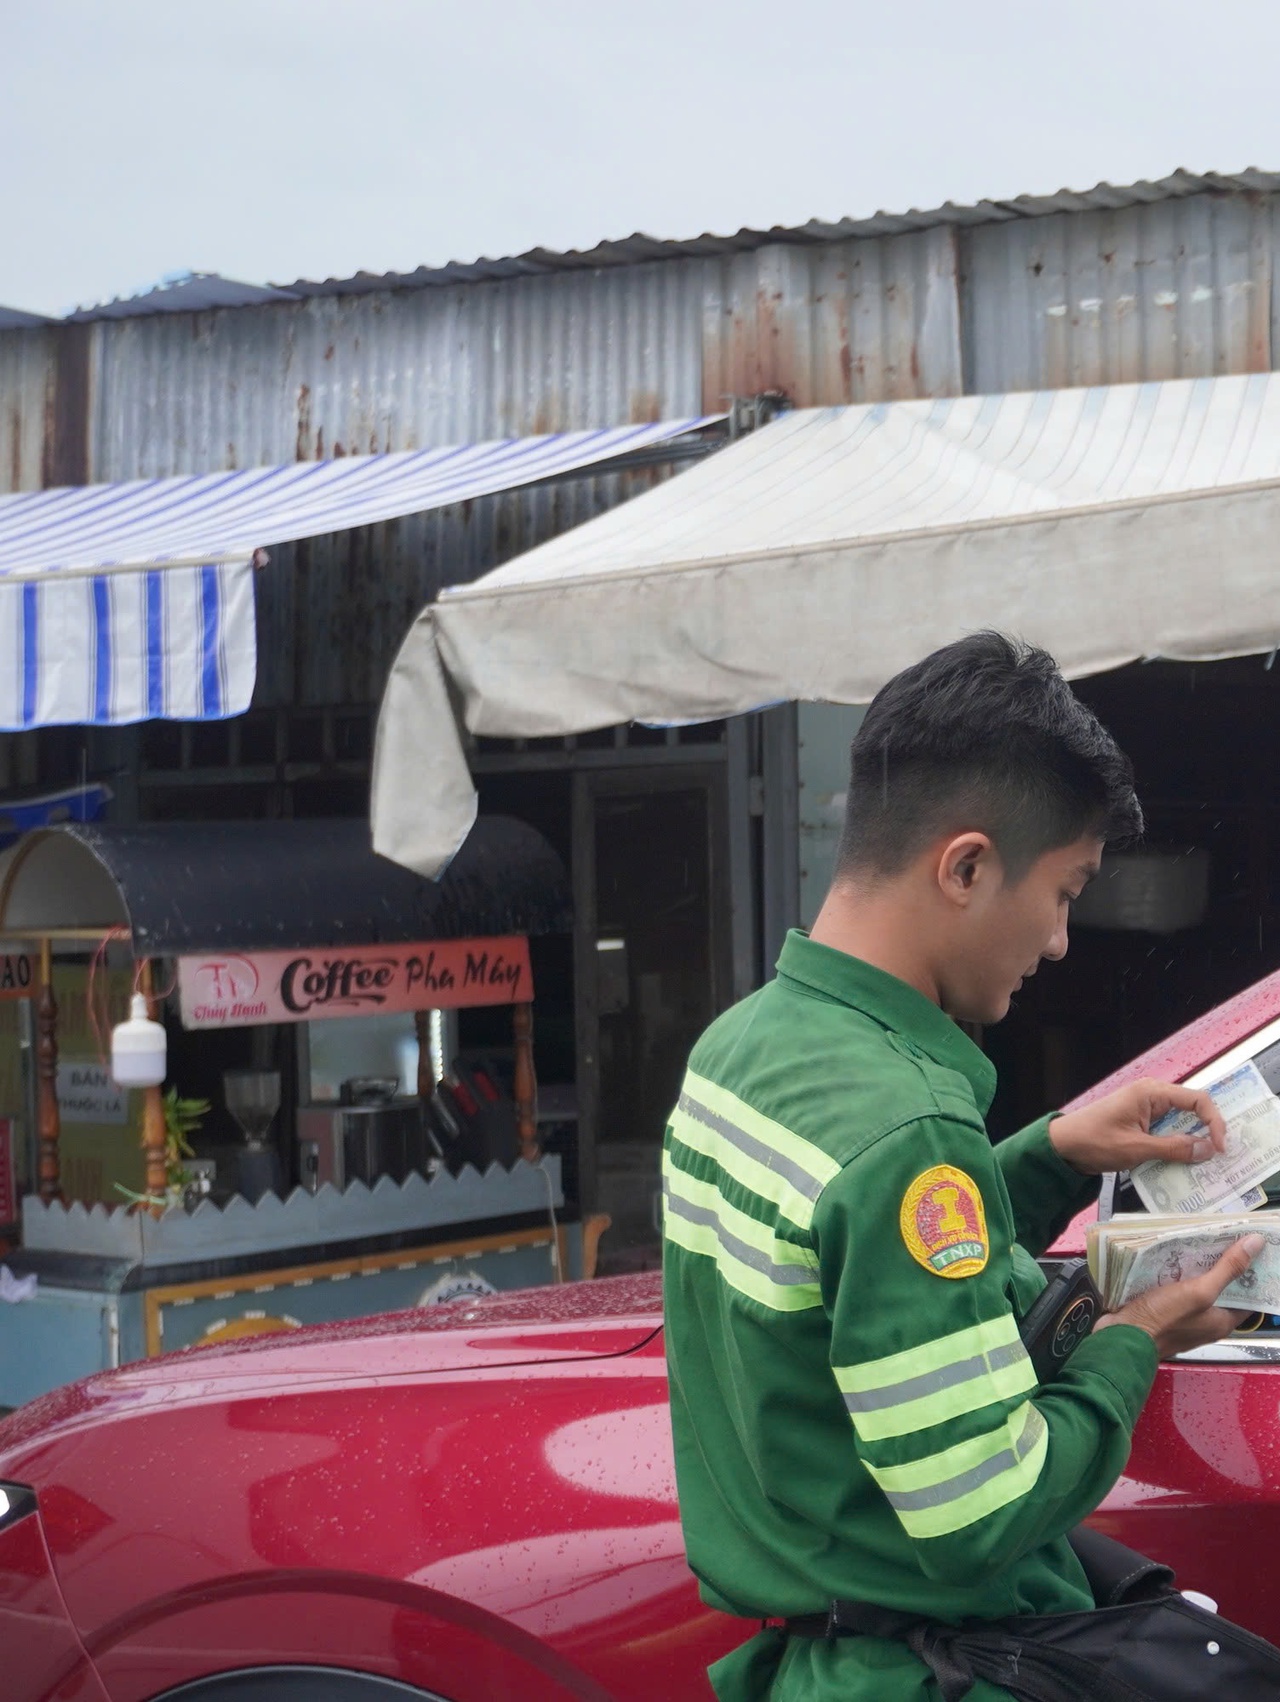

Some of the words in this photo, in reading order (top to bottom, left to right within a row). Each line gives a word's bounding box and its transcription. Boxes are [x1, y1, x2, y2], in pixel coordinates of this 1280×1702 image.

[280, 956, 398, 1014] Coffee
[406, 950, 455, 995] Pha
[463, 949, 523, 1000] Máy
[930, 1242, 982, 1266] TNXP
